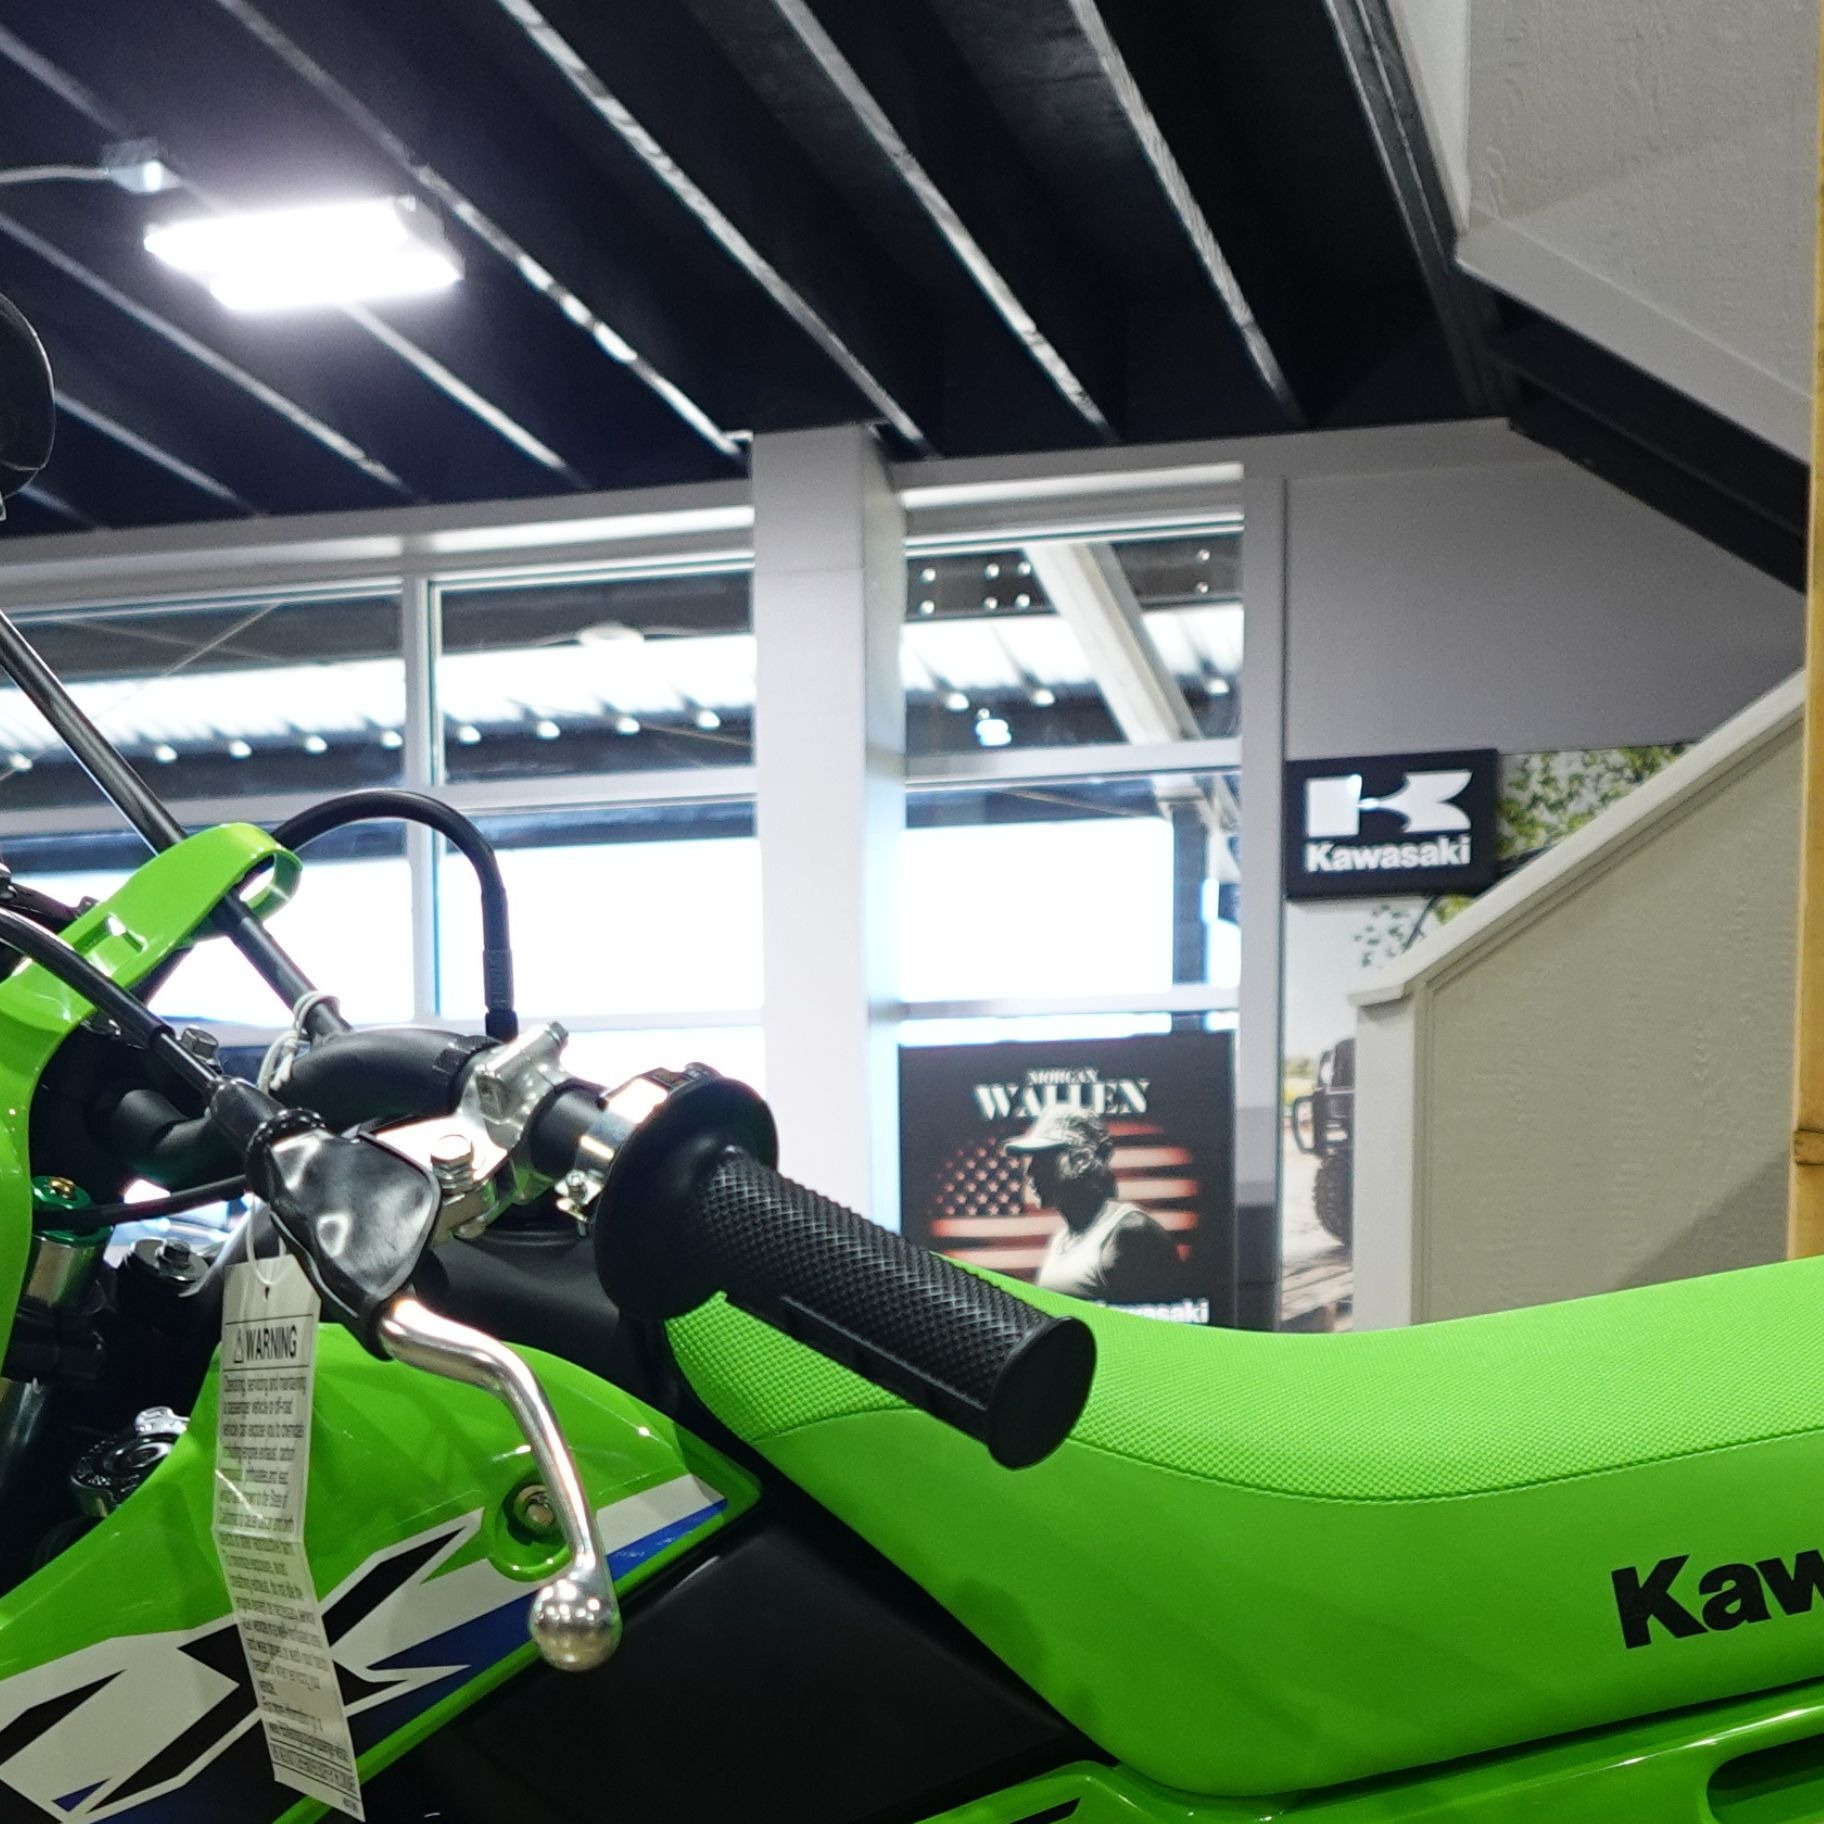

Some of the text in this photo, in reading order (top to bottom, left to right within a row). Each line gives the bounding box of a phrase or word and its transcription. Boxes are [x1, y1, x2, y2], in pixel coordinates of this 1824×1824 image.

[1307, 834, 1472, 873] Kawasaki
[1026, 1067, 1100, 1085] MORGAN
[974, 1080, 1151, 1120] WALLEN
[245, 1326, 297, 1361] WARNING
